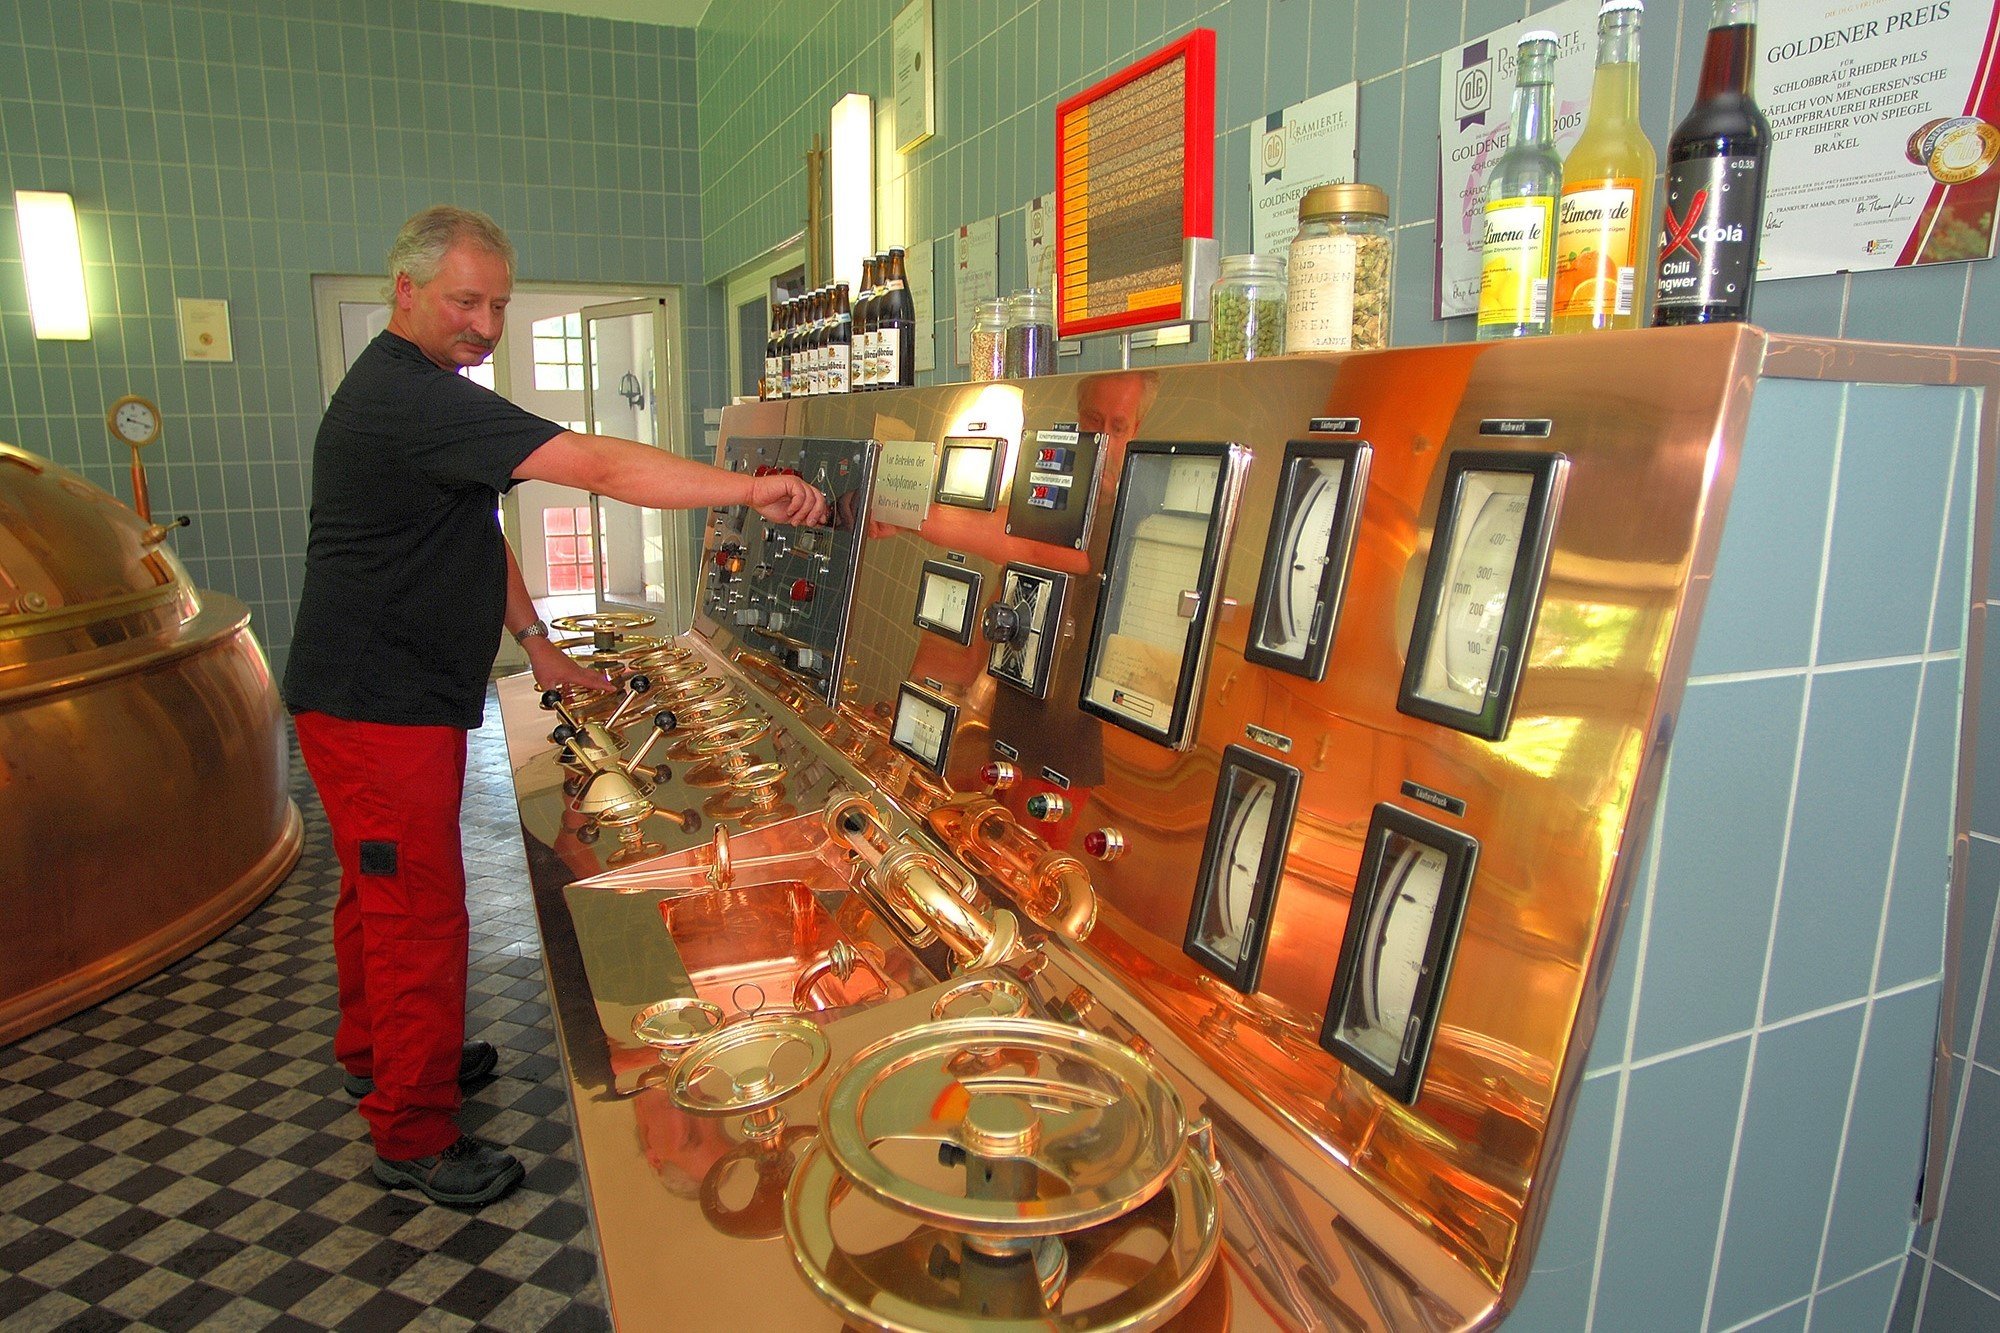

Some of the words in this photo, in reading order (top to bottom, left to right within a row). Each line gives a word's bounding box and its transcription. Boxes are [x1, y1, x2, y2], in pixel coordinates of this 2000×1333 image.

[1768, 21, 1878, 64] GOLDENER
[1886, 1, 1951, 34] PREIS
[1840, 59, 1854, 68] FÜR
[1773, 70, 1846, 96] SCHLOßBRÄU
[1850, 58, 1898, 78] RHEDER
[1900, 51, 1928, 66] PILS
[1465, 69, 1484, 102] DLG
[1837, 82, 1851, 90] DER
[1761, 100, 1806, 118] RÄFLICH
[1810, 94, 1834, 108] VON
[1836, 69, 1948, 102] MENGERSEN'SCHE
[1771, 102, 1866, 128] DAMPFBRAUEREI
[1868, 90, 1920, 108] RHEDER
[1290, 111, 1343, 140] PRÄMIERTE
[1554, 112, 1582, 133] 2005
[1772, 129, 1793, 142] OLF
[1795, 119, 1850, 138] FREIHERR
[1853, 112, 1879, 126] VON
[1881, 102, 1933, 120] SPIEGEL
[1268, 134, 1280, 160] DLG
[1814, 138, 1860, 154] BRAKEL
[1260, 188, 1301, 210] GOLDENER
[1561, 199, 1629, 224] Limonde
[1776, 204, 1809, 214] FRANKFURT
[1294, 261, 1316, 272] UND
[1663, 261, 1690, 276] Chili
[916, 456, 926, 467] der
[1506, 502, 1524, 514] 500
[1490, 534, 1506, 546] 400
[1476, 566, 1492, 580] 300
[1454, 582, 1472, 596] mm
[1469, 602, 1484, 616] 200
[1468, 641, 1481, 655] 100
